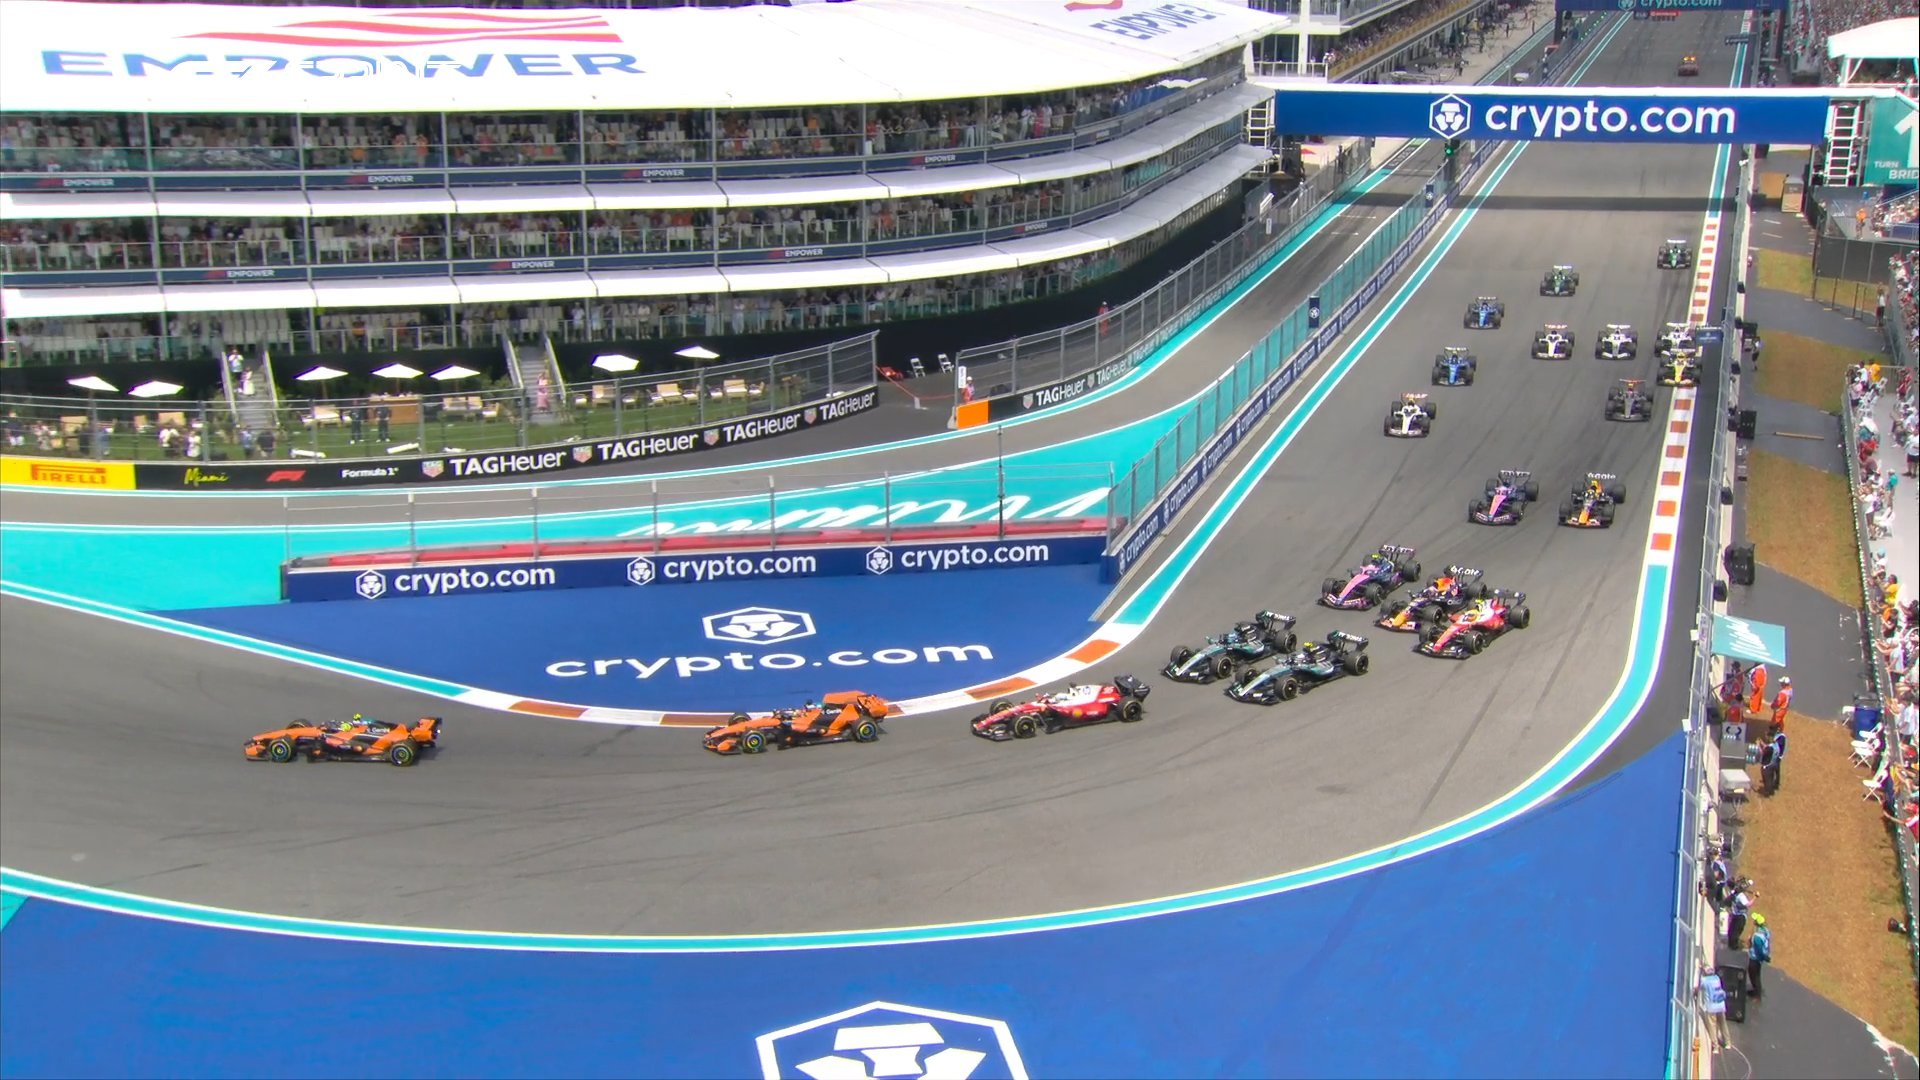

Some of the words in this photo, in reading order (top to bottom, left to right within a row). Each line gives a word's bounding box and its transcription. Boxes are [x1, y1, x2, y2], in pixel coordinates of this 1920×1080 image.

[1485, 100, 1736, 138] crypto.com
[642, 168, 685, 177] EMPOWER
[1874, 160, 1899, 169] TURN
[63, 178, 114, 187] EMPOWER
[367, 174, 414, 183] EMPOWER
[784, 248, 823, 257] EMPOWER
[511, 259, 555, 269] EMPOWER
[227, 269, 275, 279] EMPOWER
[30, 464, 106, 485] PIRELLI
[341, 467, 386, 479] Formula
[1170, 470, 1199, 513] crypto.com
[1126, 514, 1159, 563] crypto.com
[901, 544, 1049, 570] crypto.com
[663, 556, 817, 581] crypto.com
[394, 567, 556, 595] crypto.com
[545, 643, 994, 679] crypto.com
